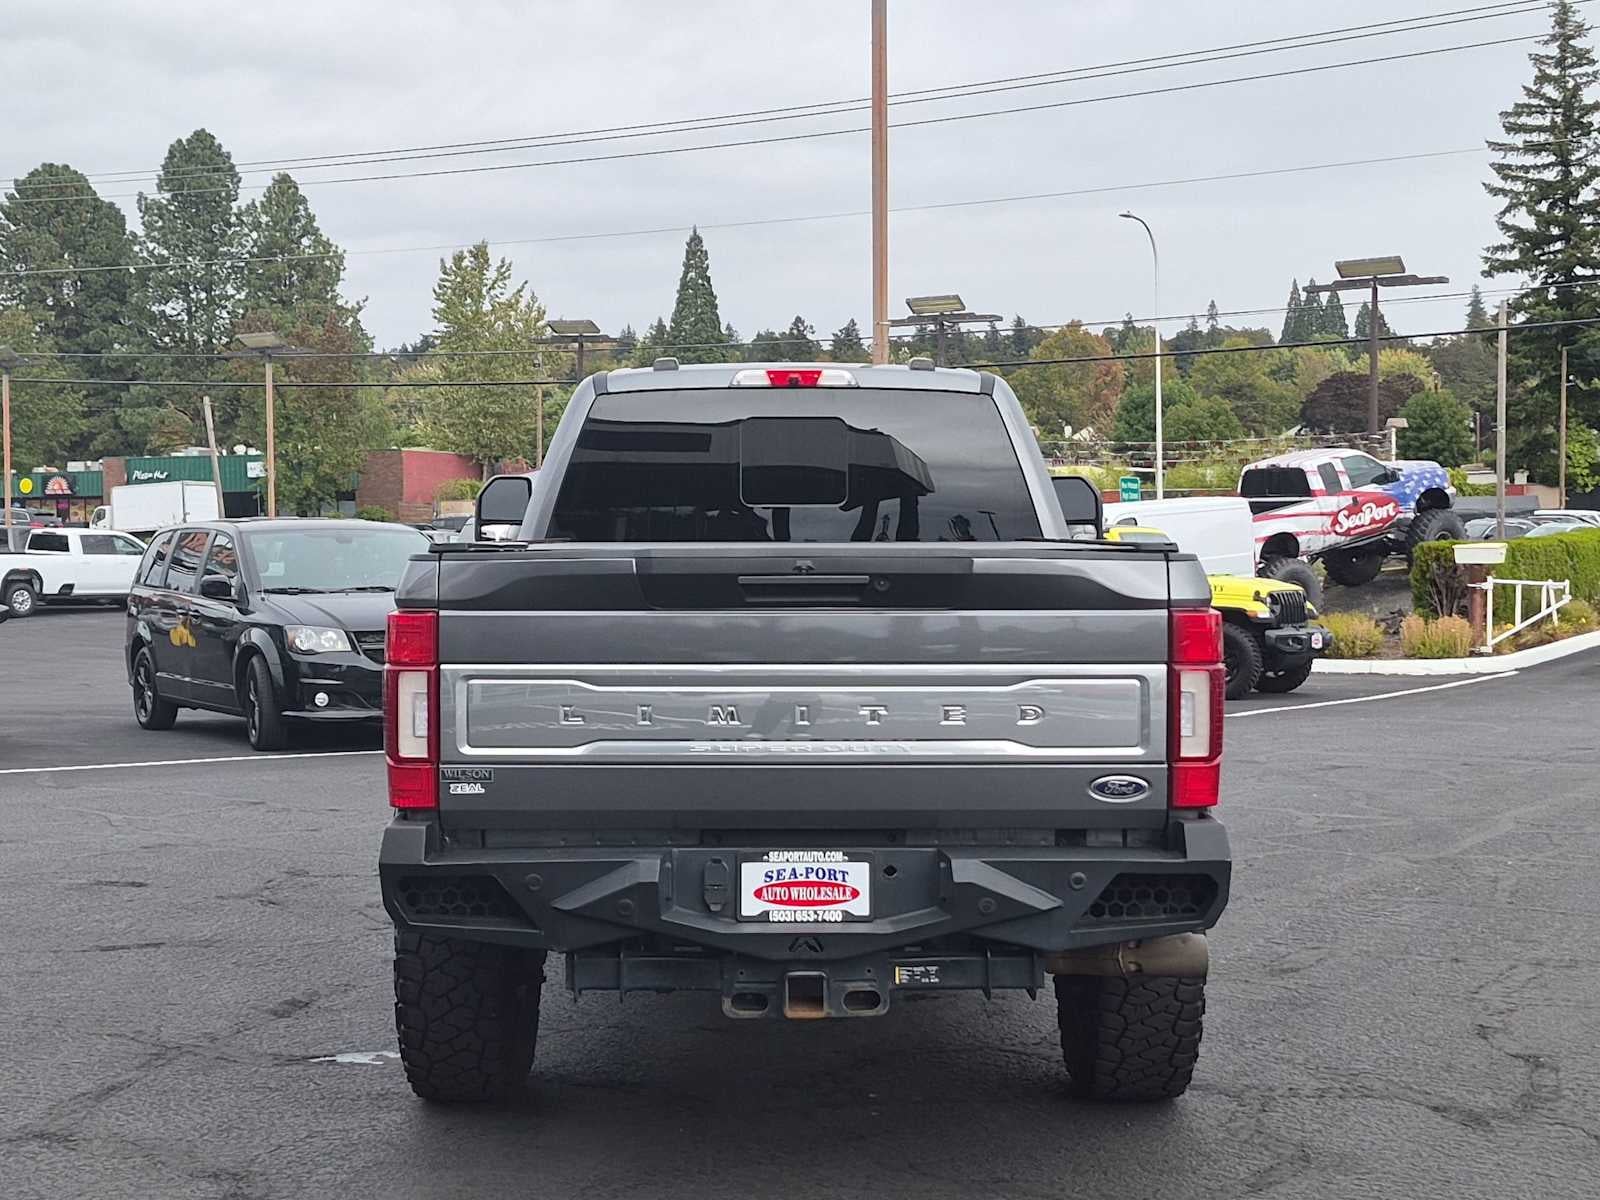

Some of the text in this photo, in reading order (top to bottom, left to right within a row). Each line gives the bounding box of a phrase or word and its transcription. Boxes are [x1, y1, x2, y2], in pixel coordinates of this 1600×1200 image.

[559, 704, 1046, 726] LIMITED
[688, 742, 812, 753] SUPER
[443, 769, 490, 778] WILSON
[768, 851, 843, 862] SEAPORTAUTO.COM
[763, 867, 849, 882] SEA-PORT
[760, 887, 852, 900] AUTO WHOLESALE
[795, 910, 843, 922] 653-7400
